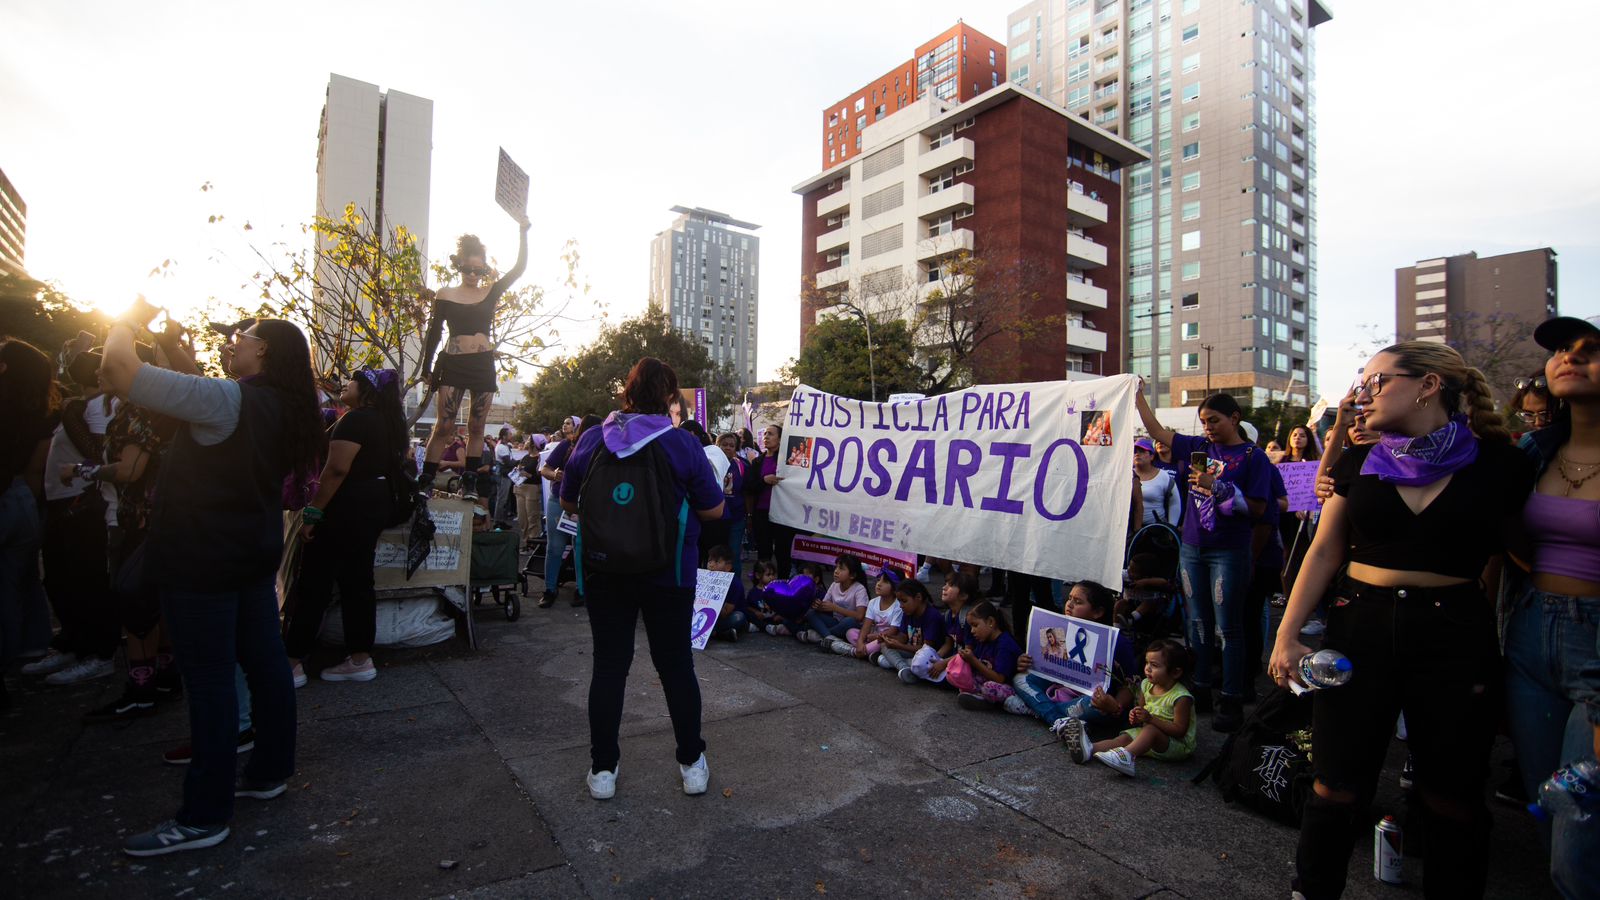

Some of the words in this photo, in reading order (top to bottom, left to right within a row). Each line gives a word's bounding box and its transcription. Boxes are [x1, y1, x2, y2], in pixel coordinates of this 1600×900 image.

[789, 391, 949, 432] #JUSTICIA
[958, 391, 1031, 430] PARA
[806, 436, 1089, 521] ROSARIO
[802, 503, 813, 525] Y
[818, 508, 840, 532] SU
[848, 513, 895, 543] BEBE
